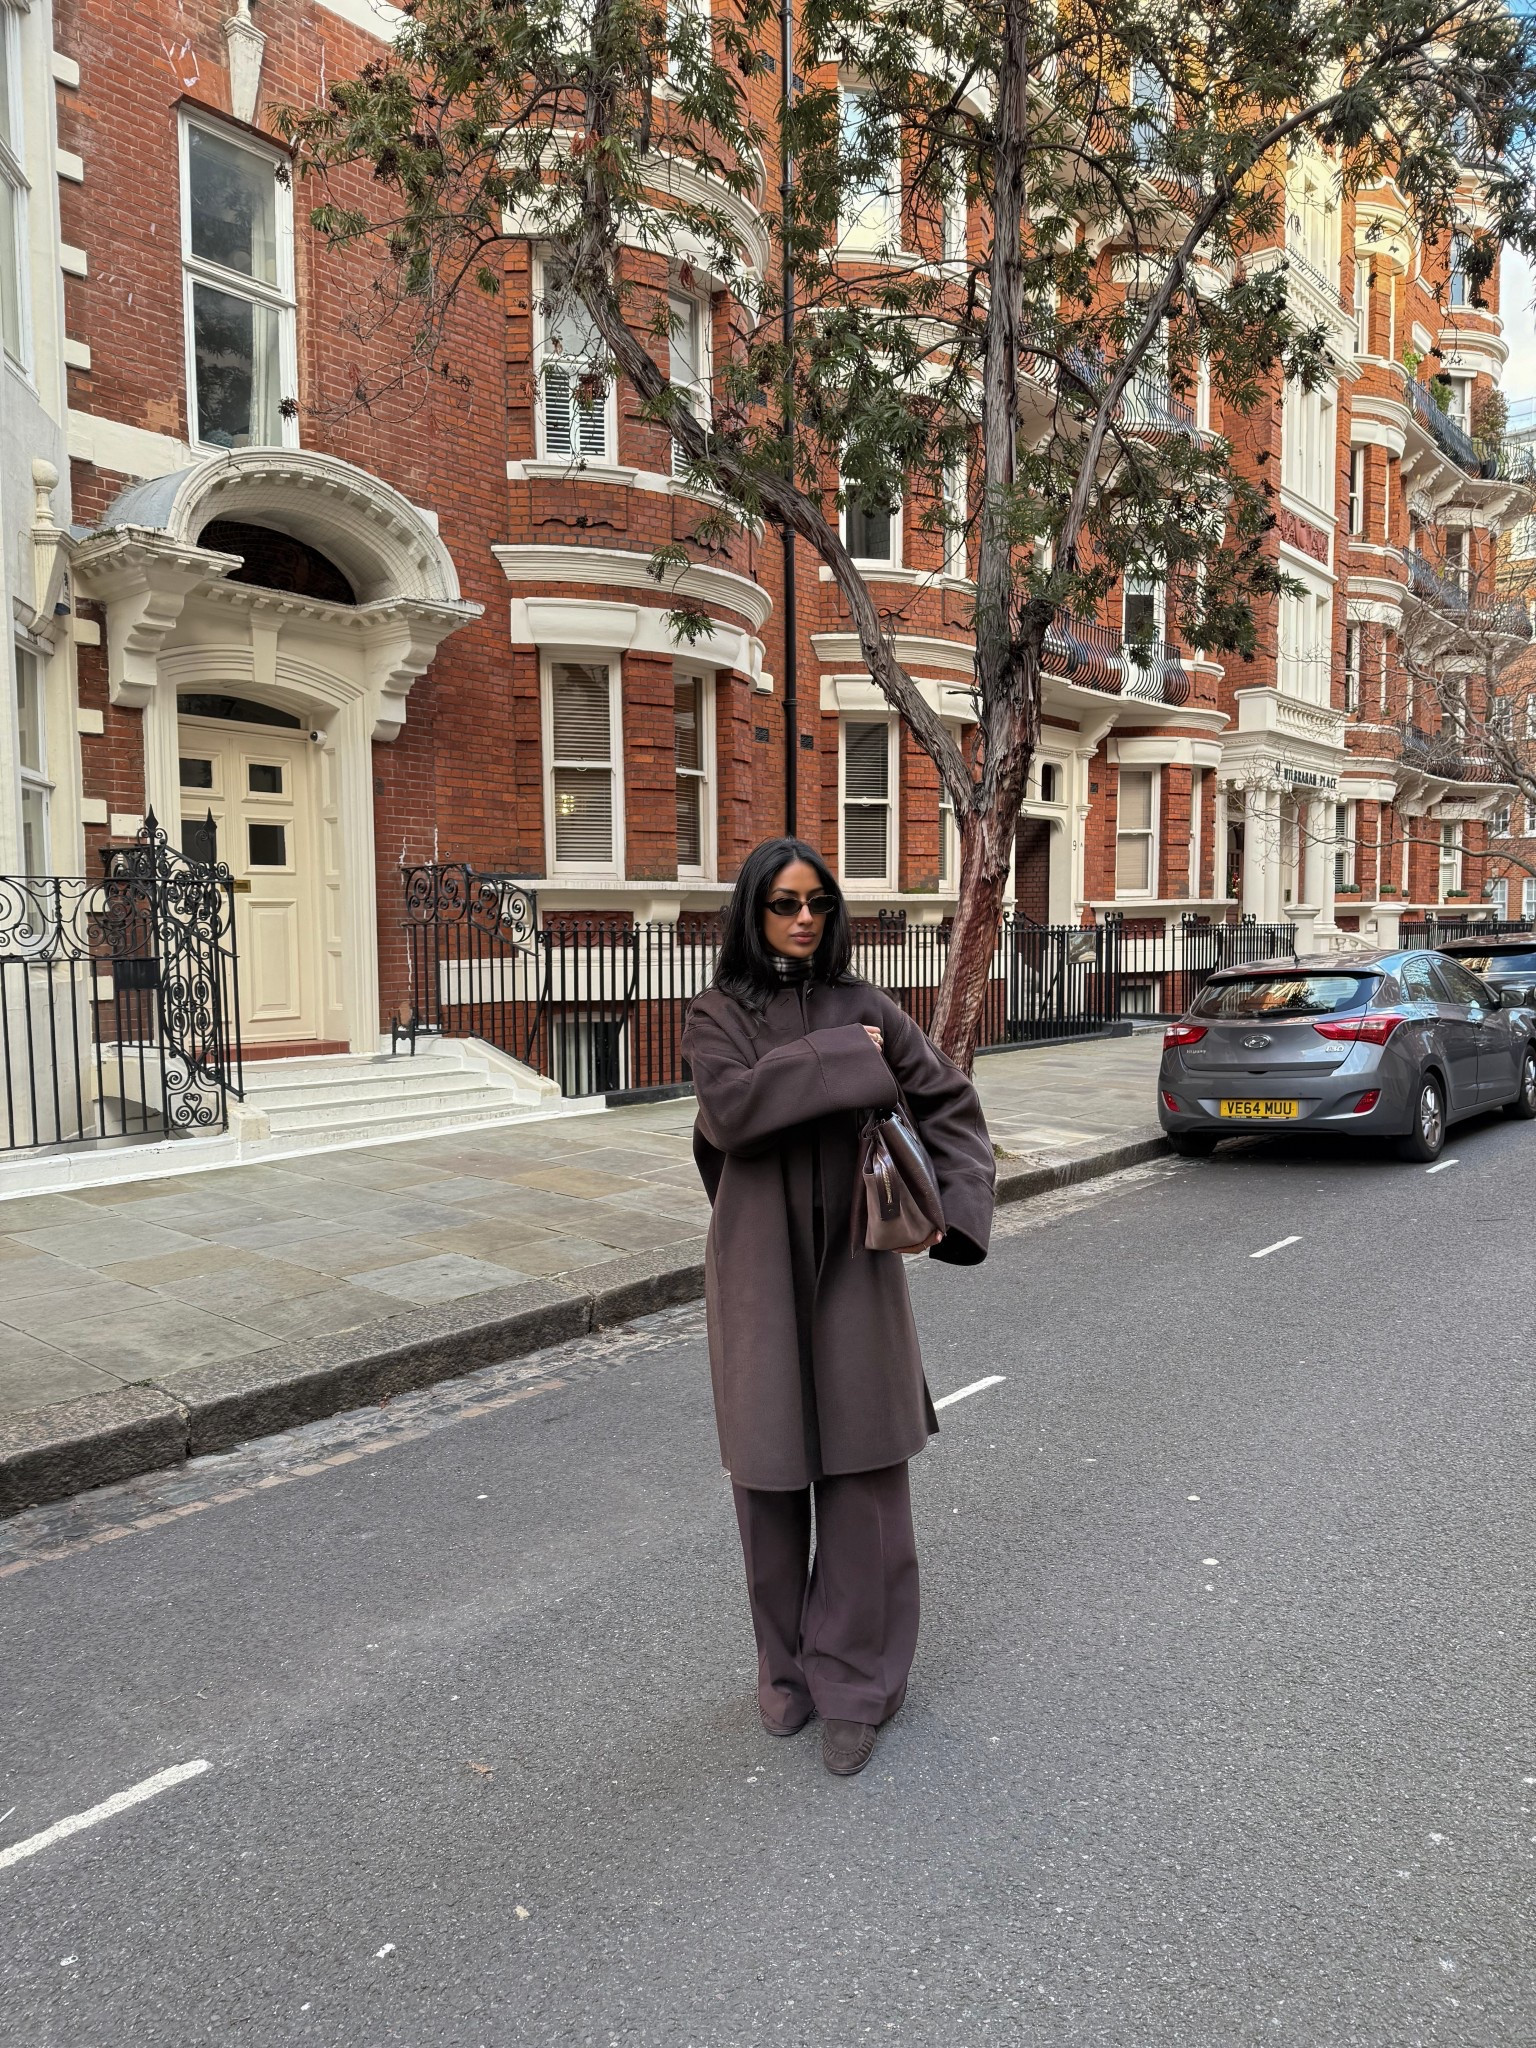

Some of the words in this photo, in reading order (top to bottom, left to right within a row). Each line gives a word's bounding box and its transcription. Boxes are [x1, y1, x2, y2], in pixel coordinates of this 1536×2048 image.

[221, 698, 237, 716] 7
[1319, 775, 1338, 789] PLACE
[1073, 840, 1077, 851] 9
[1227, 1102, 1260, 1114] VE64
[1264, 1102, 1292, 1115] MUU
